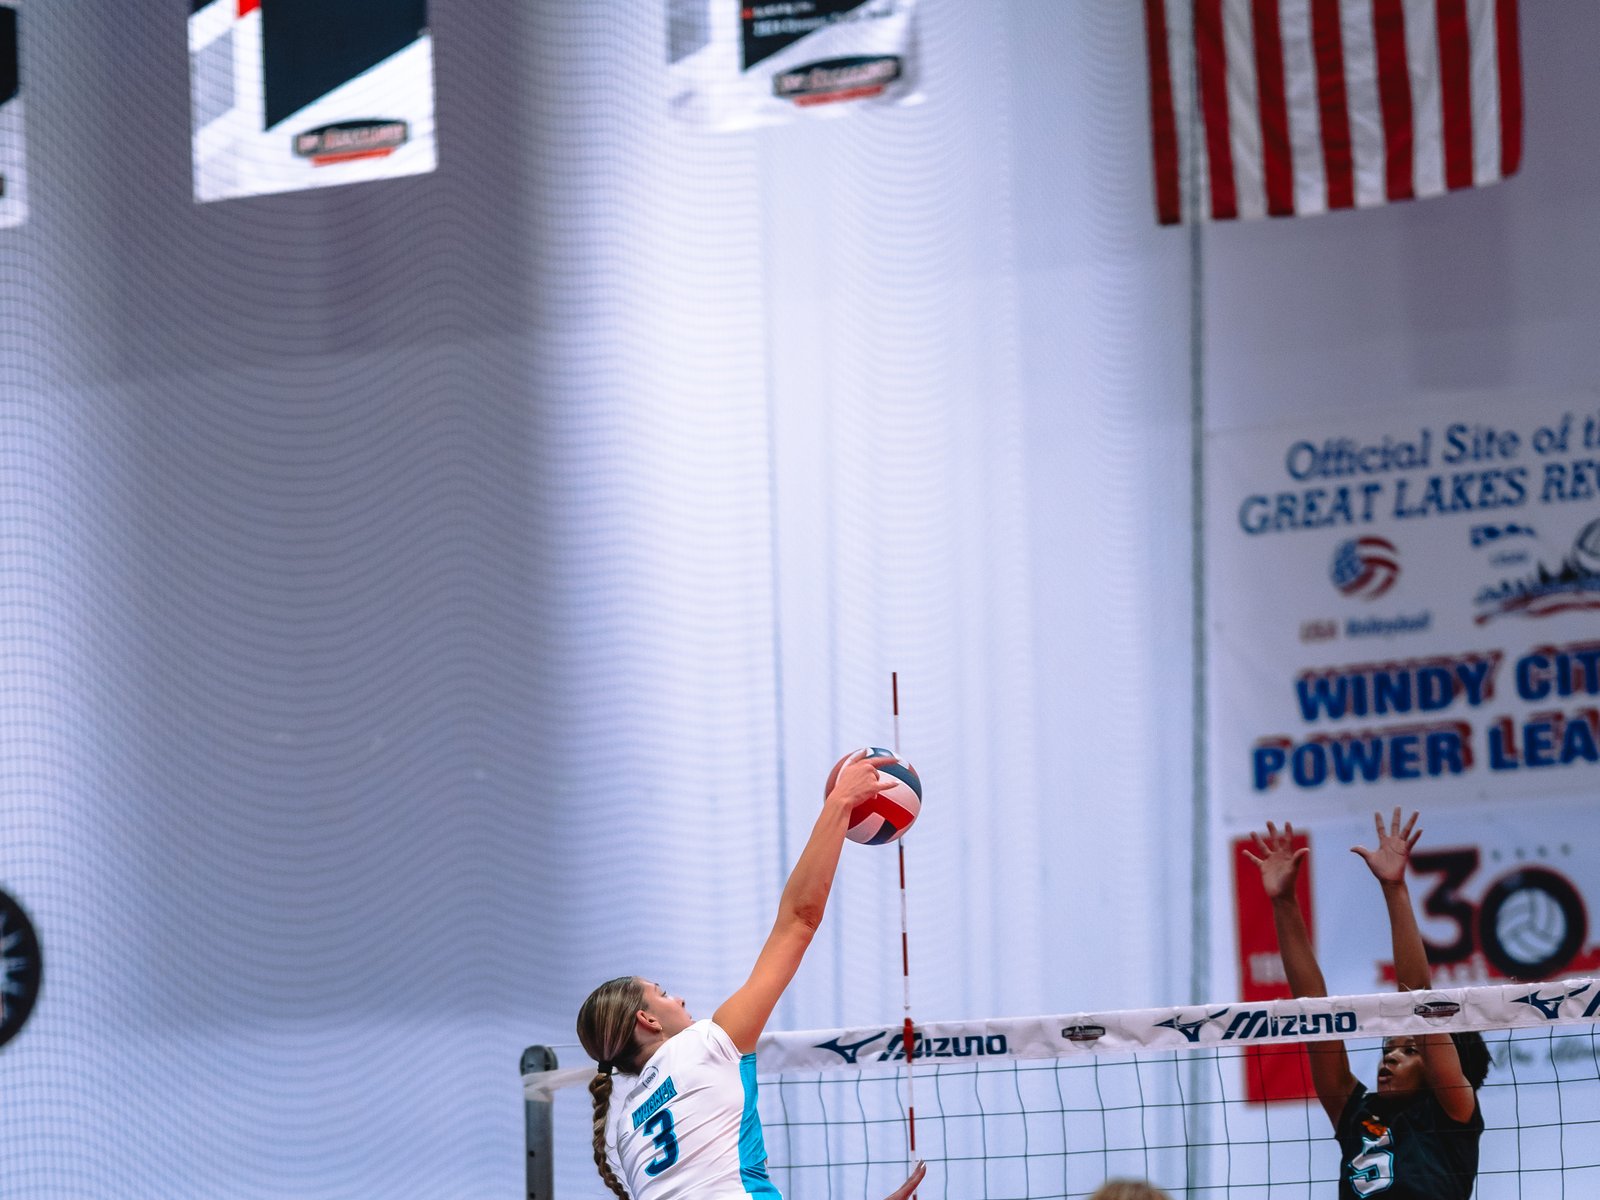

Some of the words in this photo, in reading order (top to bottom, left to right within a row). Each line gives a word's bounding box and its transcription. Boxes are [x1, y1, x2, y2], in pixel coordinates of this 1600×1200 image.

[1286, 428, 1432, 480] Official
[1444, 424, 1520, 464] Site
[1532, 411, 1574, 455] of
[1239, 482, 1381, 535] GREAT
[1393, 466, 1528, 519] LAKES
[1296, 653, 1501, 721] WINDY
[1253, 721, 1474, 790] POWER
[642, 1107, 680, 1177] 3
[1348, 1127, 1394, 1199] 5
